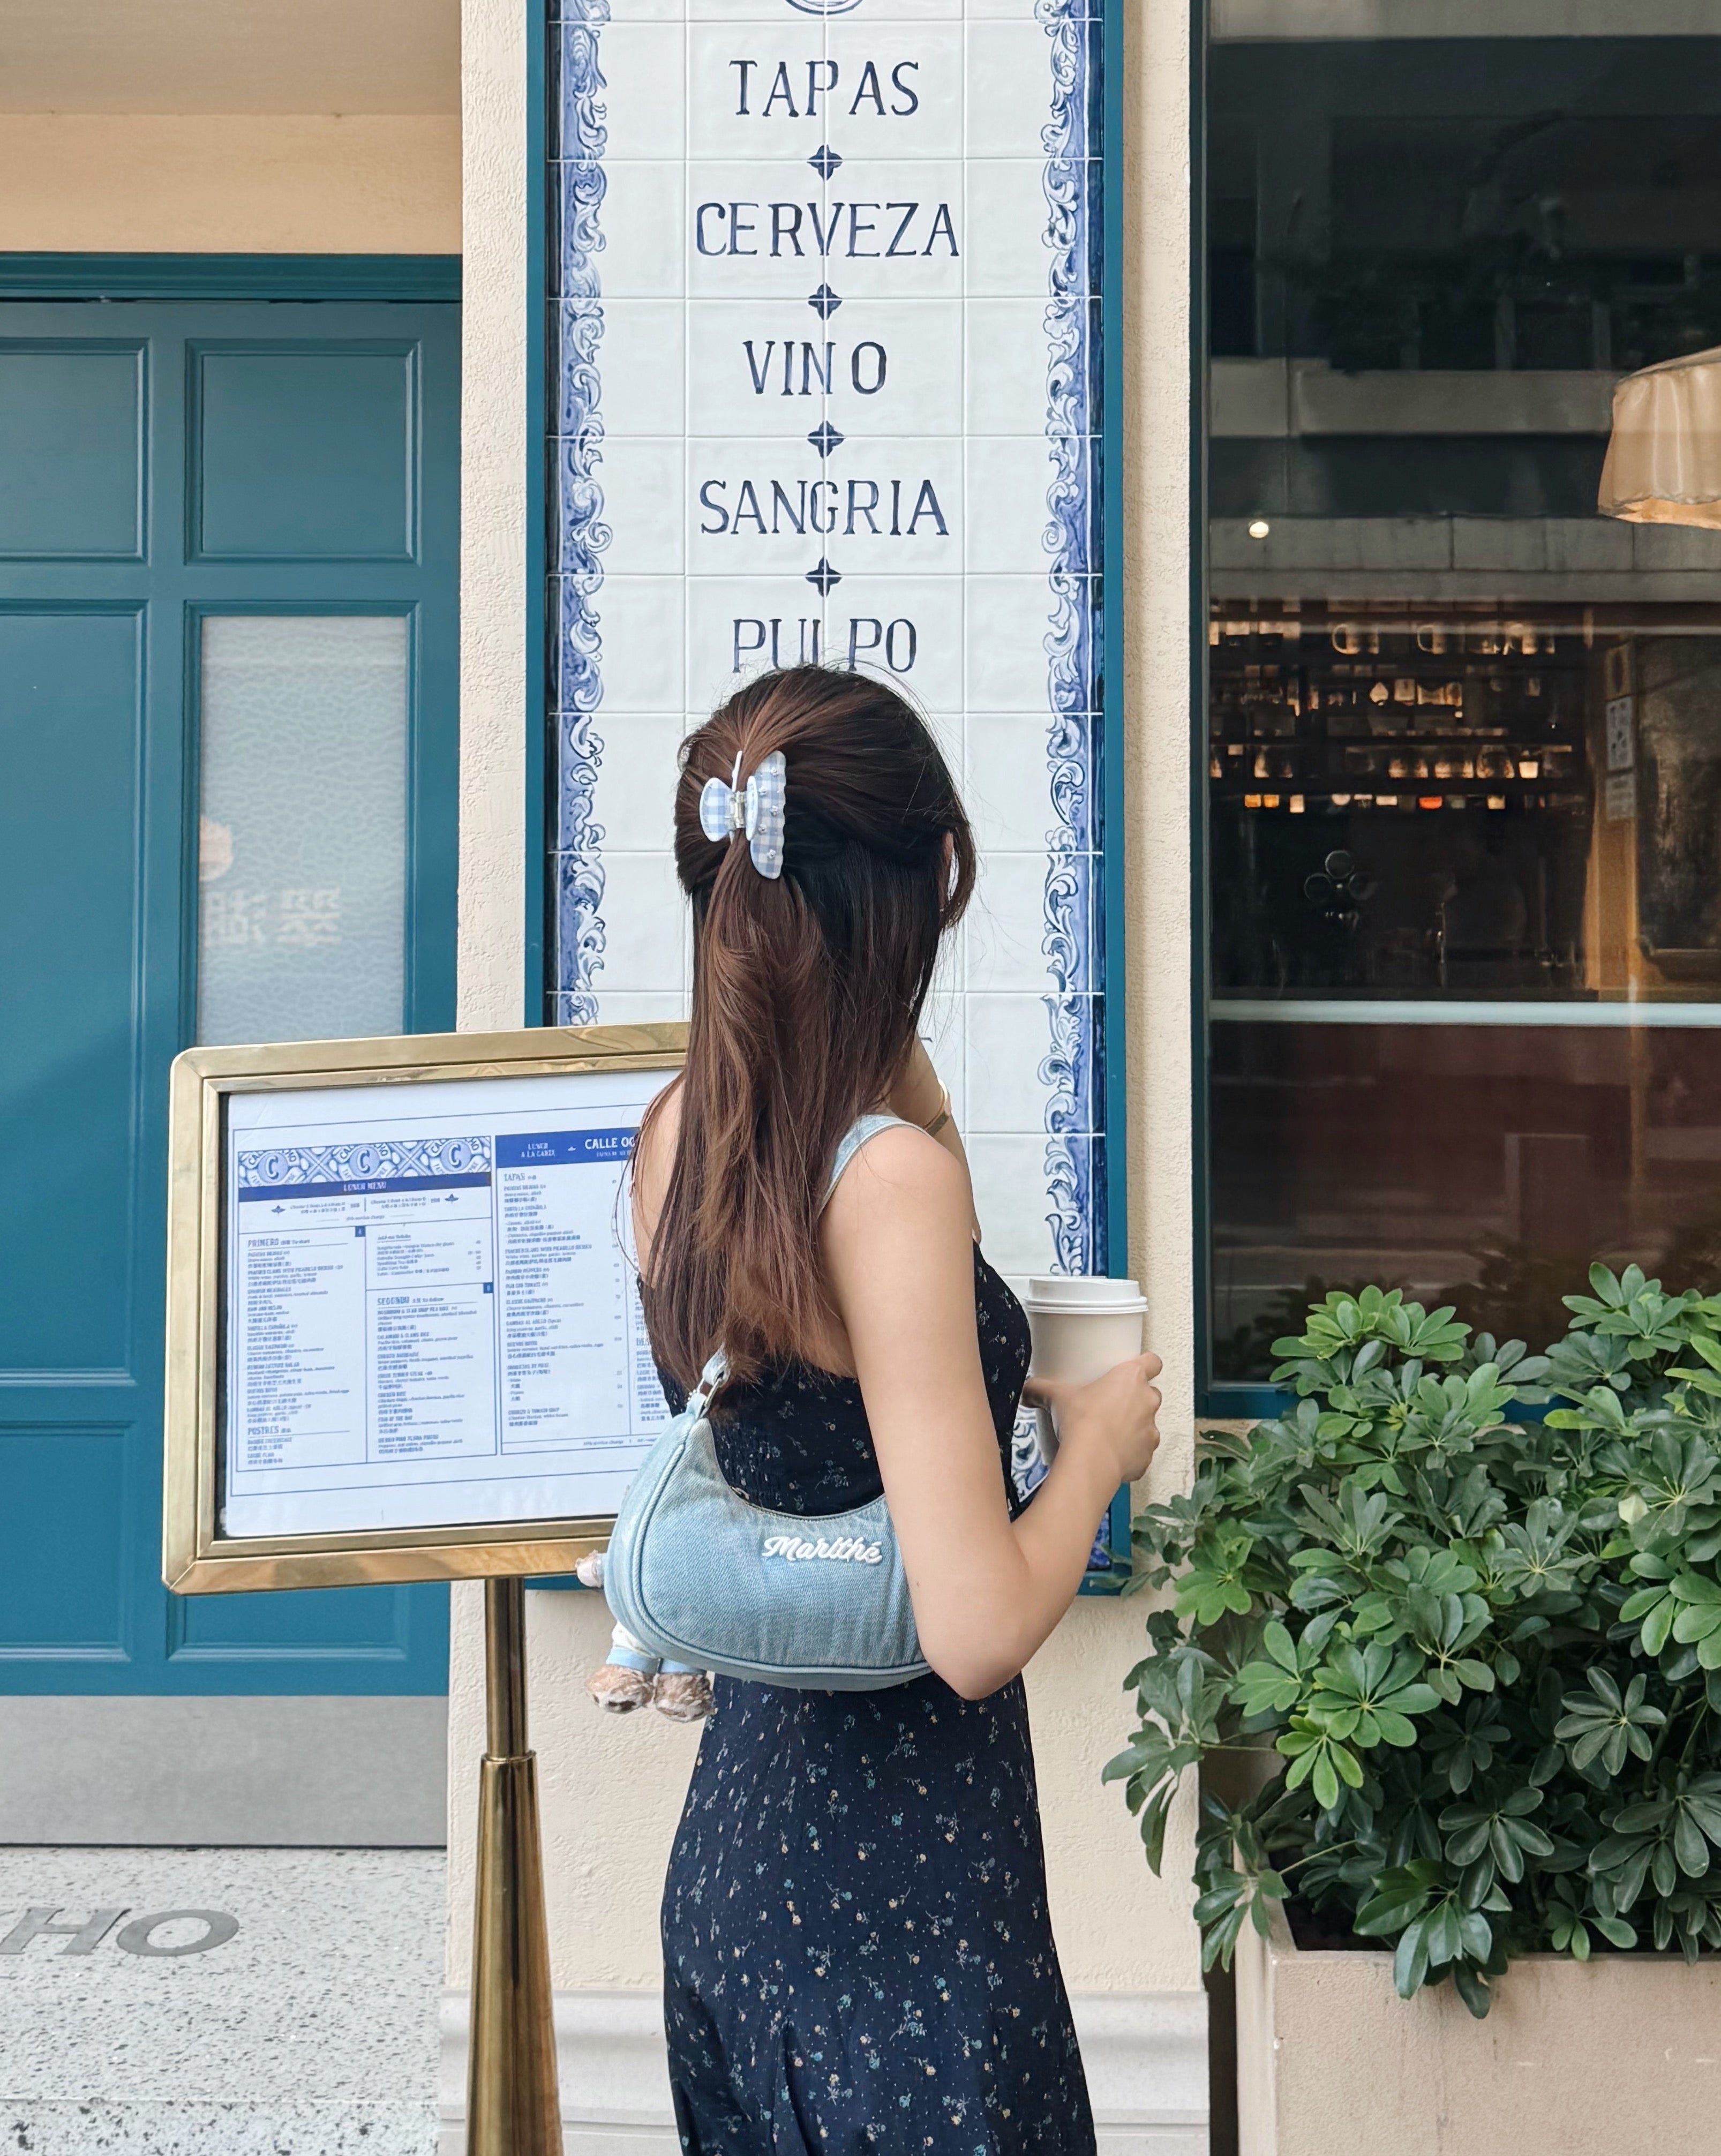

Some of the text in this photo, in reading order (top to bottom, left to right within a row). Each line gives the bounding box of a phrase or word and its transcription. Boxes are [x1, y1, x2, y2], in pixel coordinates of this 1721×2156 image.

[728, 59, 920, 117] TAPAS
[696, 201, 960, 257] CERVEZA
[742, 340, 888, 396] VINO
[699, 479, 950, 536] SANGRIA
[584, 1138, 618, 1150] CALLE
[0, 1907, 239, 1957] HO
